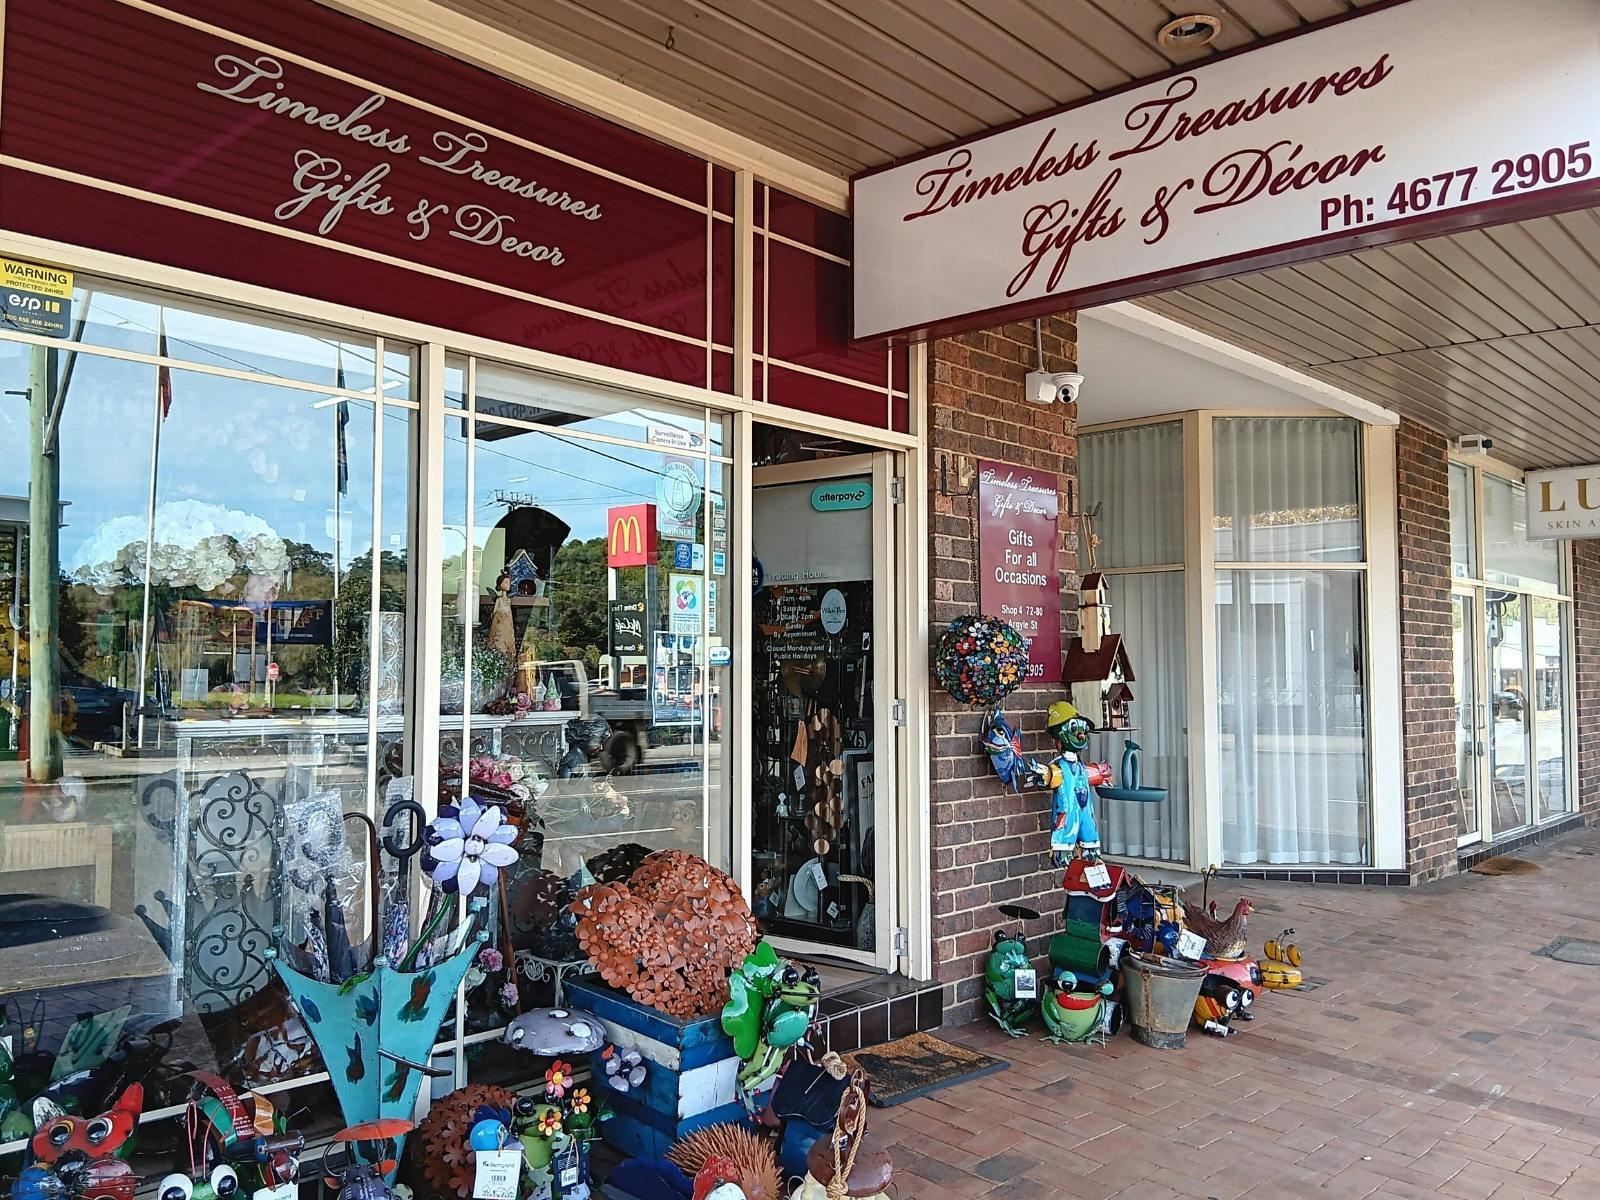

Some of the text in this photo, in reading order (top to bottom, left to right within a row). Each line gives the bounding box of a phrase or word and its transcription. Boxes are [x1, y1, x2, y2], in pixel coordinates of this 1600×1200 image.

[197, 54, 602, 220] Timeless Treasures
[903, 54, 1393, 221] Timeless Treasures
[1321, 141, 1592, 231] Ph: 4677 2905
[275, 150, 565, 266] Gifts & Decor
[1006, 140, 1385, 297] Gifts & Décor
[4, 263, 68, 284] WARNING
[6, 280, 64, 295] PROTECTED 24HRS
[981, 469, 1056, 495] Timeless Treasures
[819, 493, 855, 502] afterpay
[992, 493, 1013, 518] Gifts
[1548, 521, 1580, 529] SKIN
[1009, 529, 1033, 546] Gifts
[1005, 549, 1037, 566] For all
[995, 567, 1047, 586] Occasions
[1001, 604, 1043, 616] Shop 4 72-80
[673, 623, 700, 632] ENDORED
[783, 630, 817, 638] Appointment
[1008, 619, 1038, 631] Argyle St
